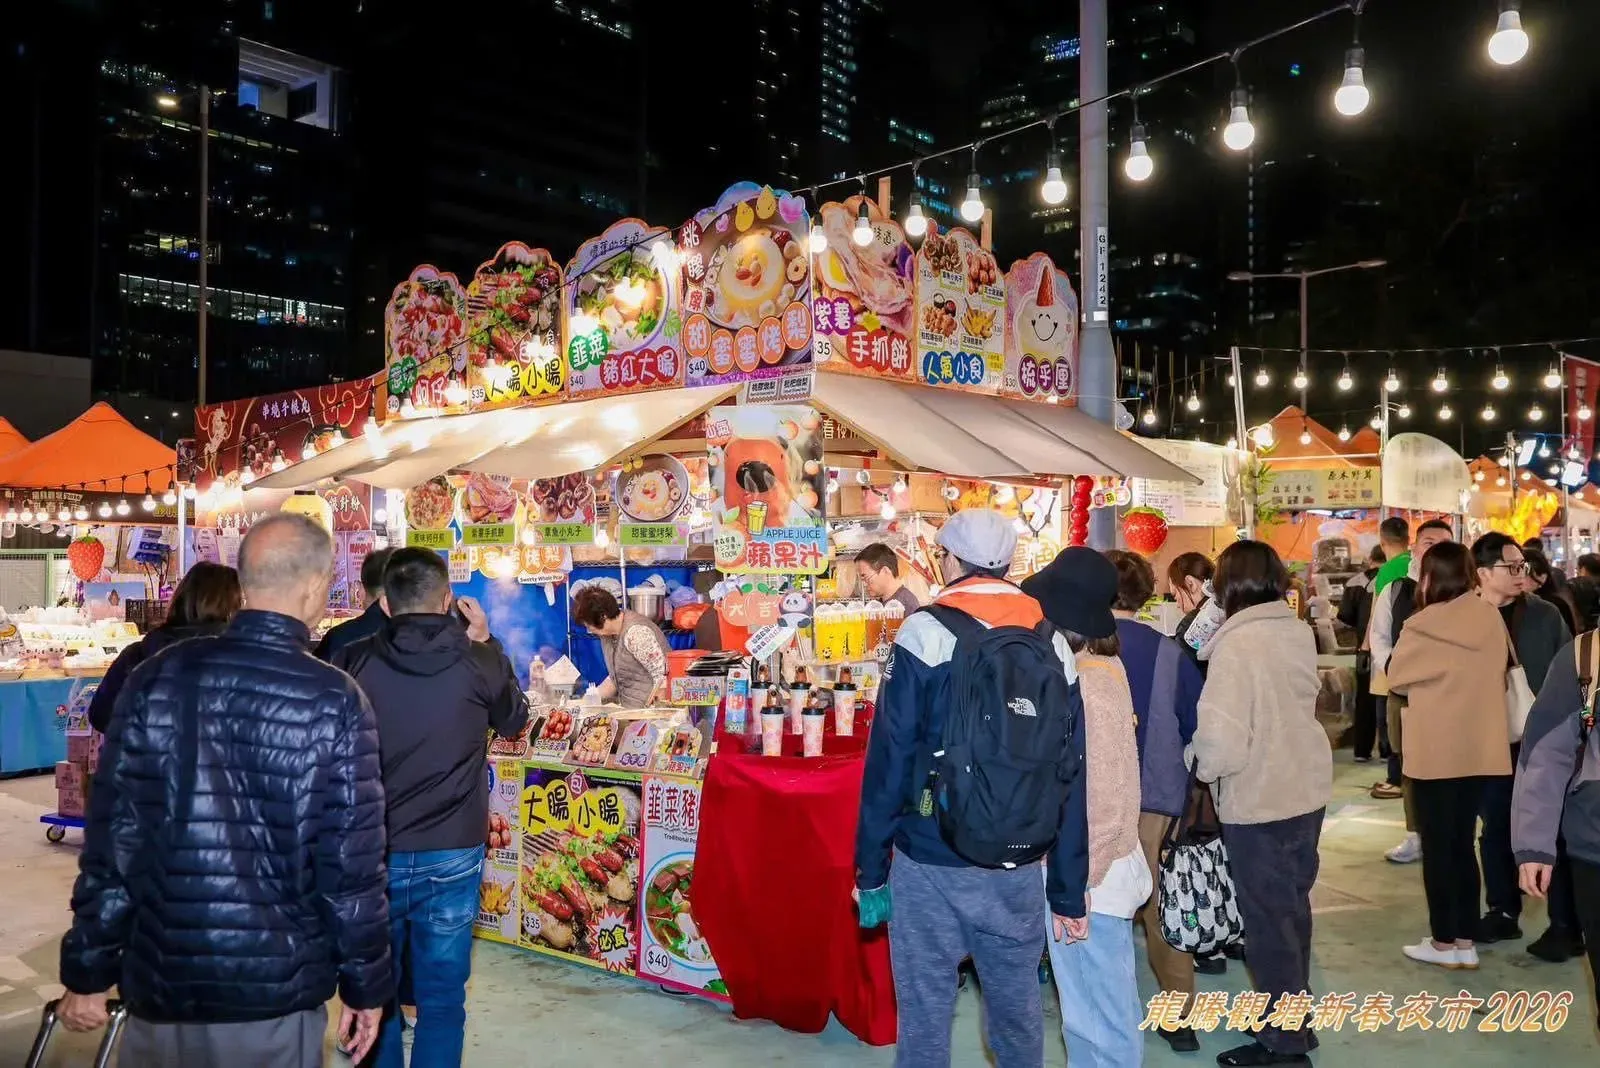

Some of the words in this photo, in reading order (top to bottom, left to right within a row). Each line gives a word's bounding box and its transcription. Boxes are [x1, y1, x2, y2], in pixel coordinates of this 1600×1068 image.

[814, 298, 851, 330] 紫薯
[852, 330, 908, 370] 手抓餅
[603, 349, 675, 385] 豬紅大腸
[688, 360, 706, 374] $40
[926, 355, 982, 380] 人氣小食
[570, 375, 584, 386] $40
[471, 388, 484, 399] $35
[544, 525, 582, 537] 章魚小丸子
[631, 526, 673, 539] 甜蜜蜜烤梨
[766, 529, 795, 539] APPLE
[796, 529, 821, 539] JUICE
[747, 540, 824, 569] 蘋果汁
[728, 602, 774, 617] 大吉
[876, 647, 889, 657] $20
[501, 785, 516, 796] $100
[664, 833, 688, 842] Traditional
[525, 917, 540, 929] $35
[598, 924, 629, 953] 必食
[647, 950, 668, 968] $40
